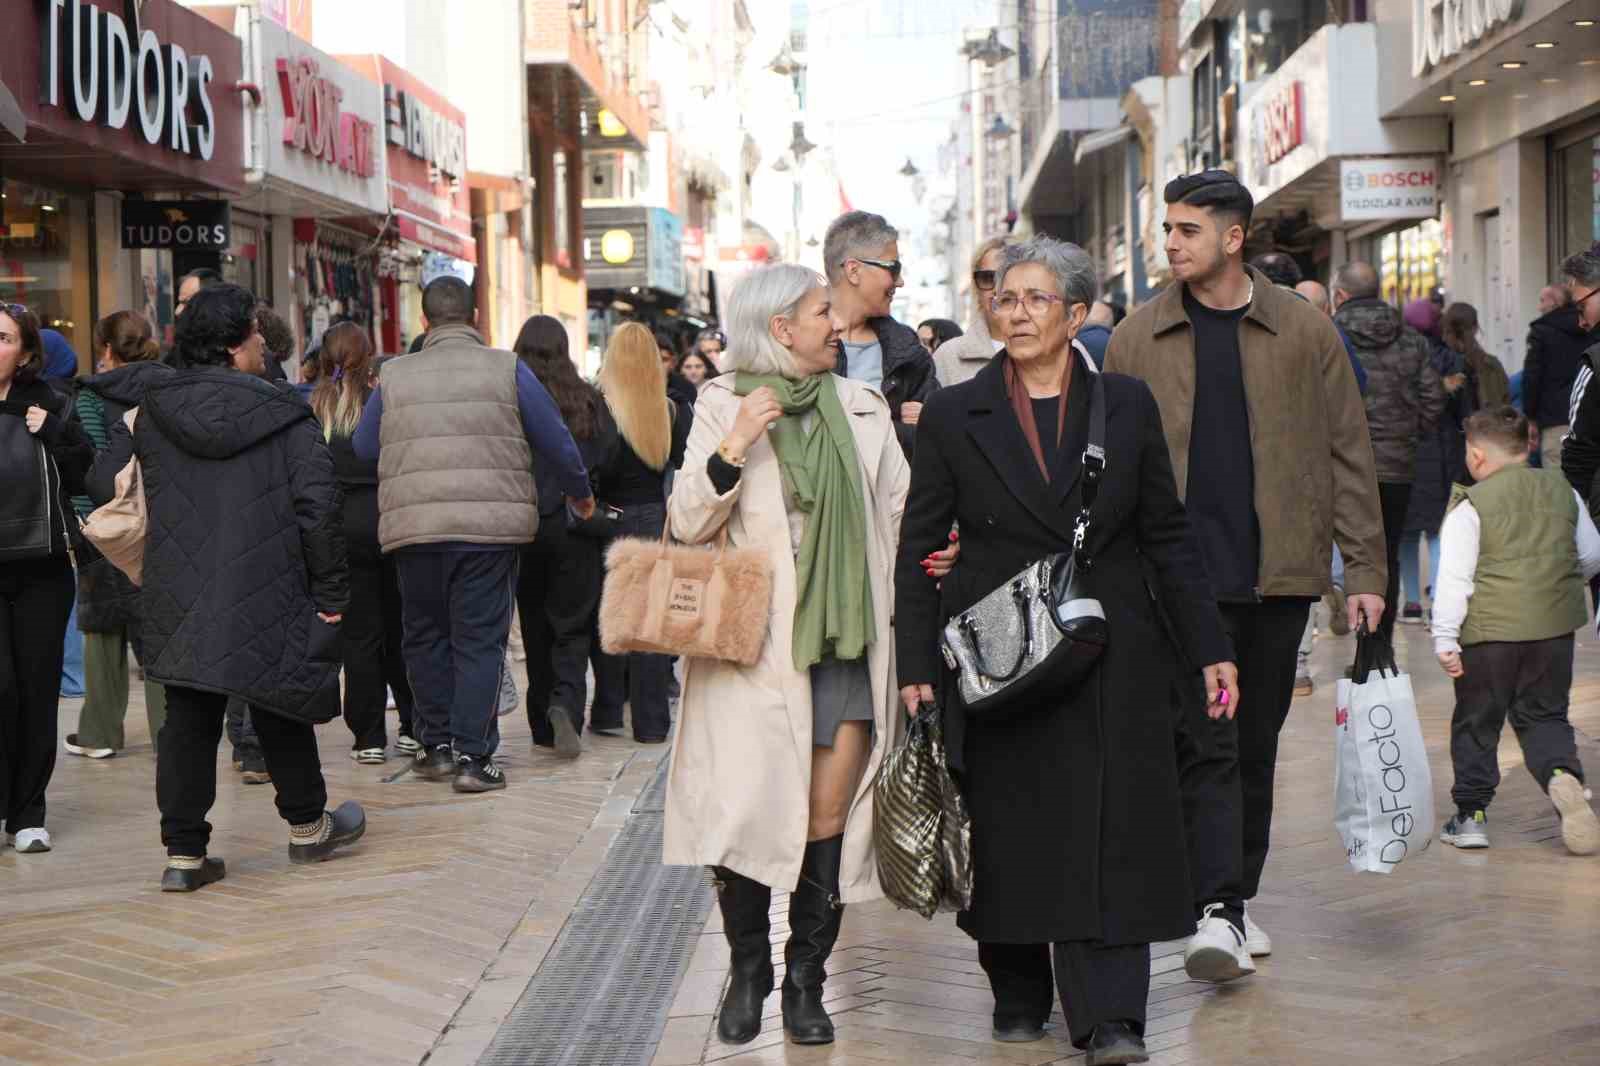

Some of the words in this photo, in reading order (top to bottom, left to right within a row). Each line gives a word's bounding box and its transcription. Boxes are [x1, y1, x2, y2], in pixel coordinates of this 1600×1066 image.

[46, 0, 215, 161] TUDORS
[1368, 171, 1433, 188] BOSCH
[127, 224, 226, 244] TUDORS
[1368, 704, 1414, 864] DeFacto
